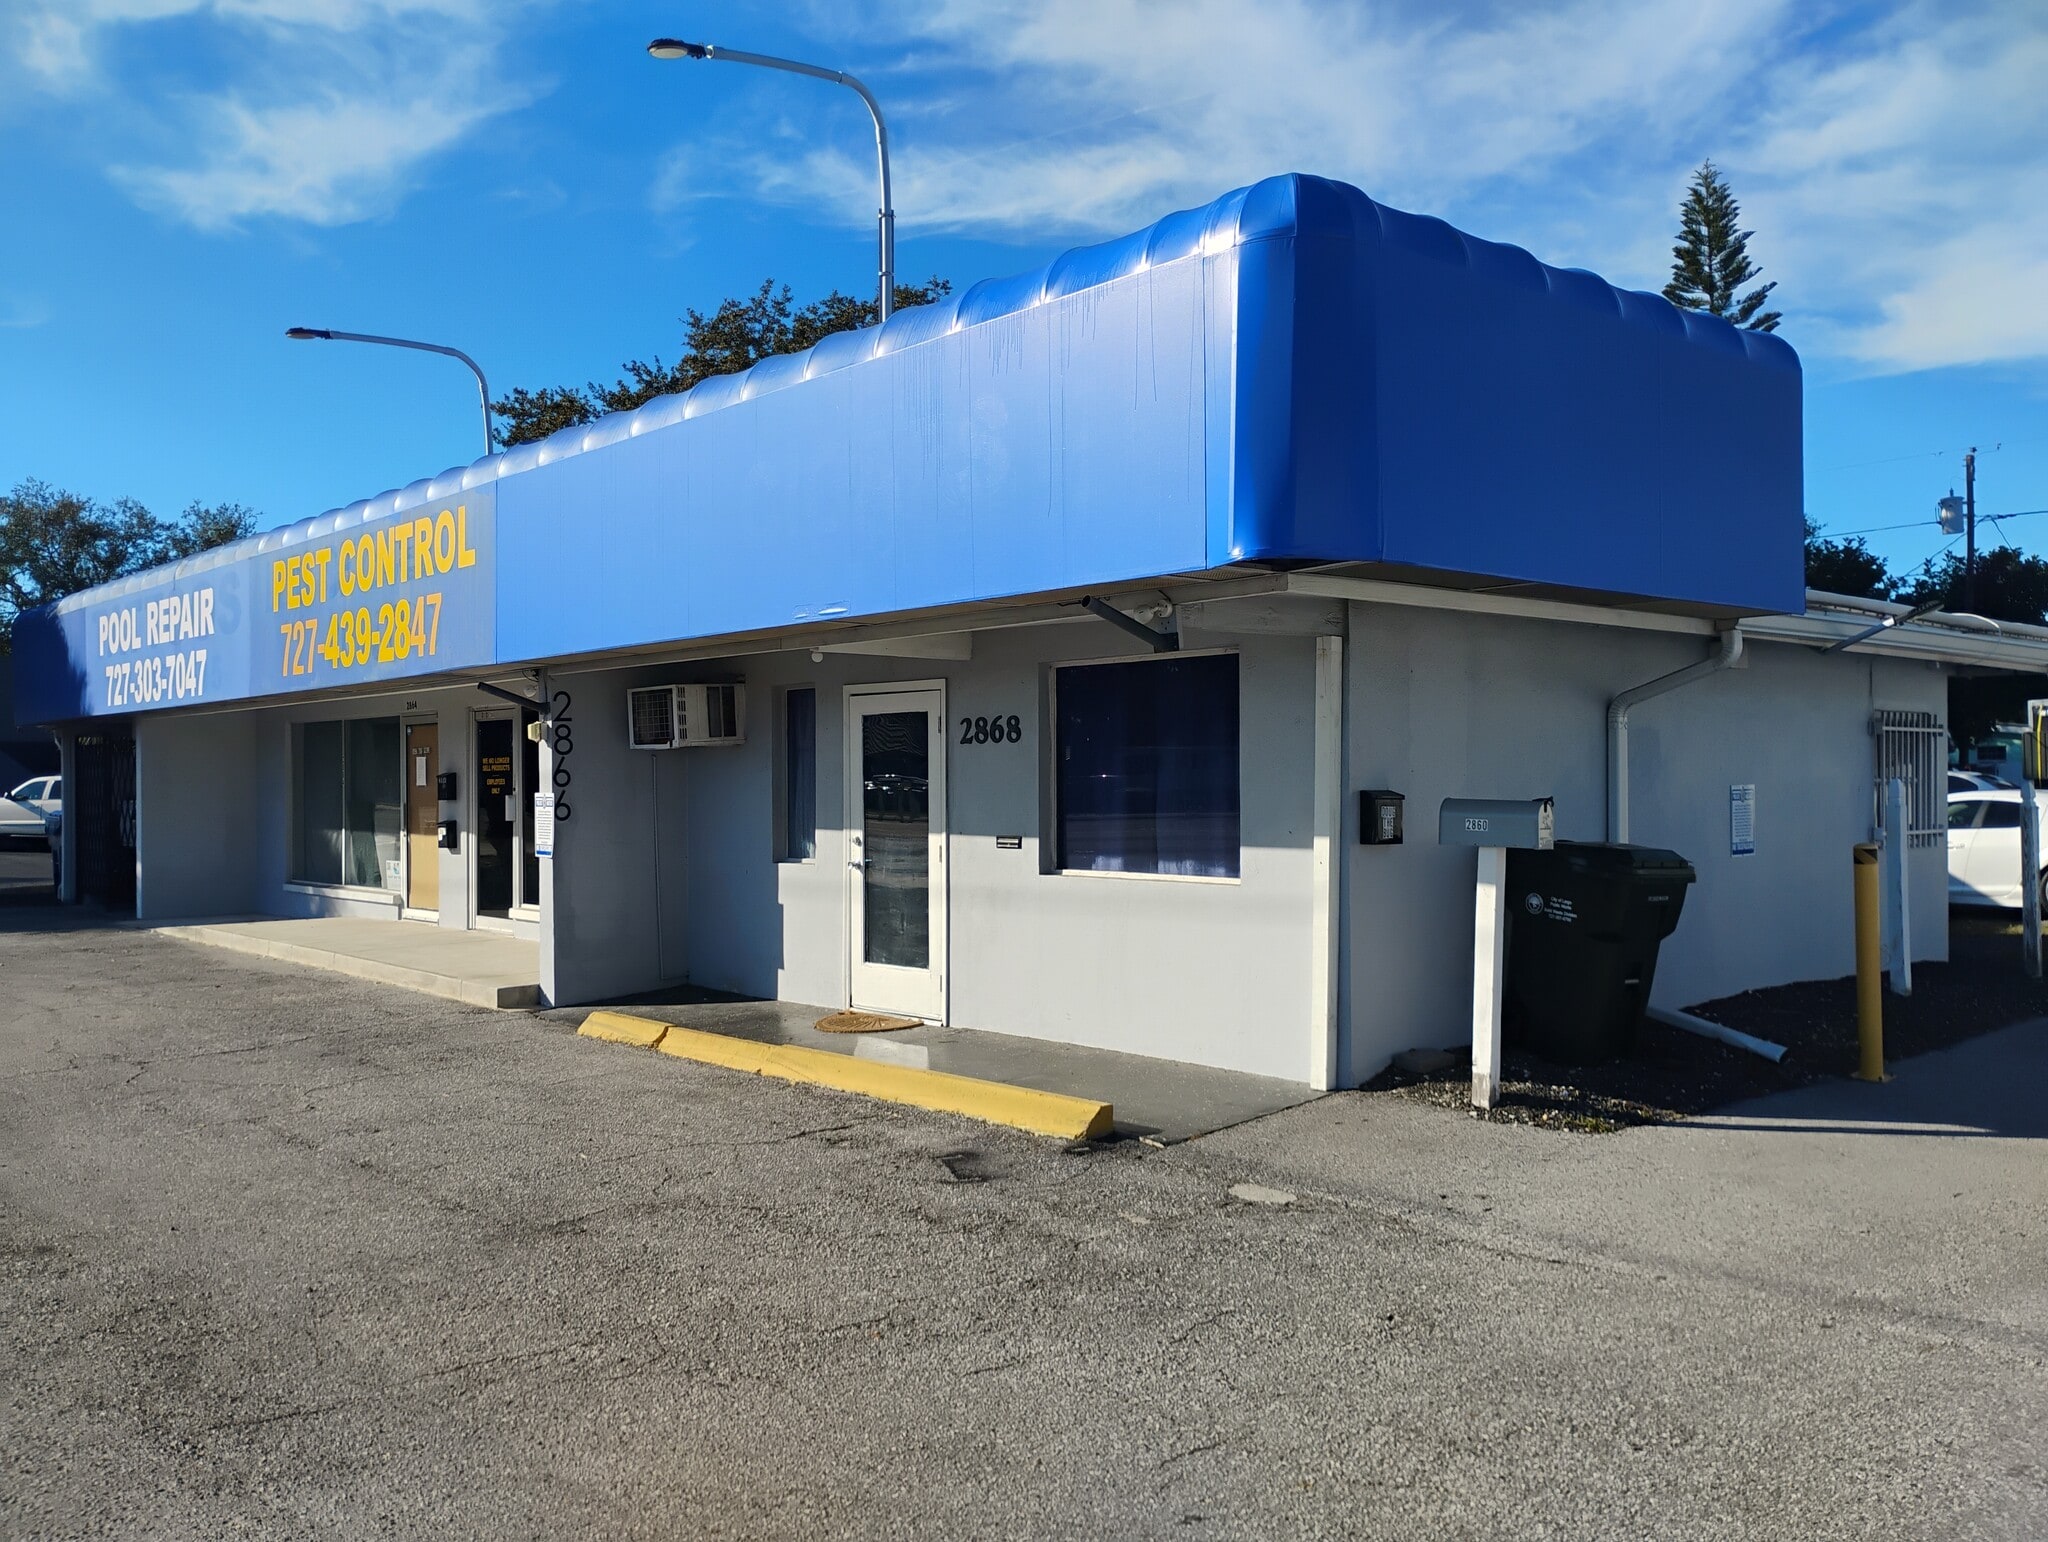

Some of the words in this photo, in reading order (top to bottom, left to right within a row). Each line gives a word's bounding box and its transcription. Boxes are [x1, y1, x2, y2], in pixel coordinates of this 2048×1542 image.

[272, 547, 333, 613] PEST
[338, 505, 476, 597] CONTROL
[99, 607, 142, 657] POOL
[146, 587, 215, 646] REPAIR
[280, 592, 443, 677] 727-439-2847
[105, 648, 208, 707] 727-303-7047
[553, 690, 574, 822] 2866
[959, 714, 1022, 745] 2868
[1466, 819, 1488, 831] 2860
